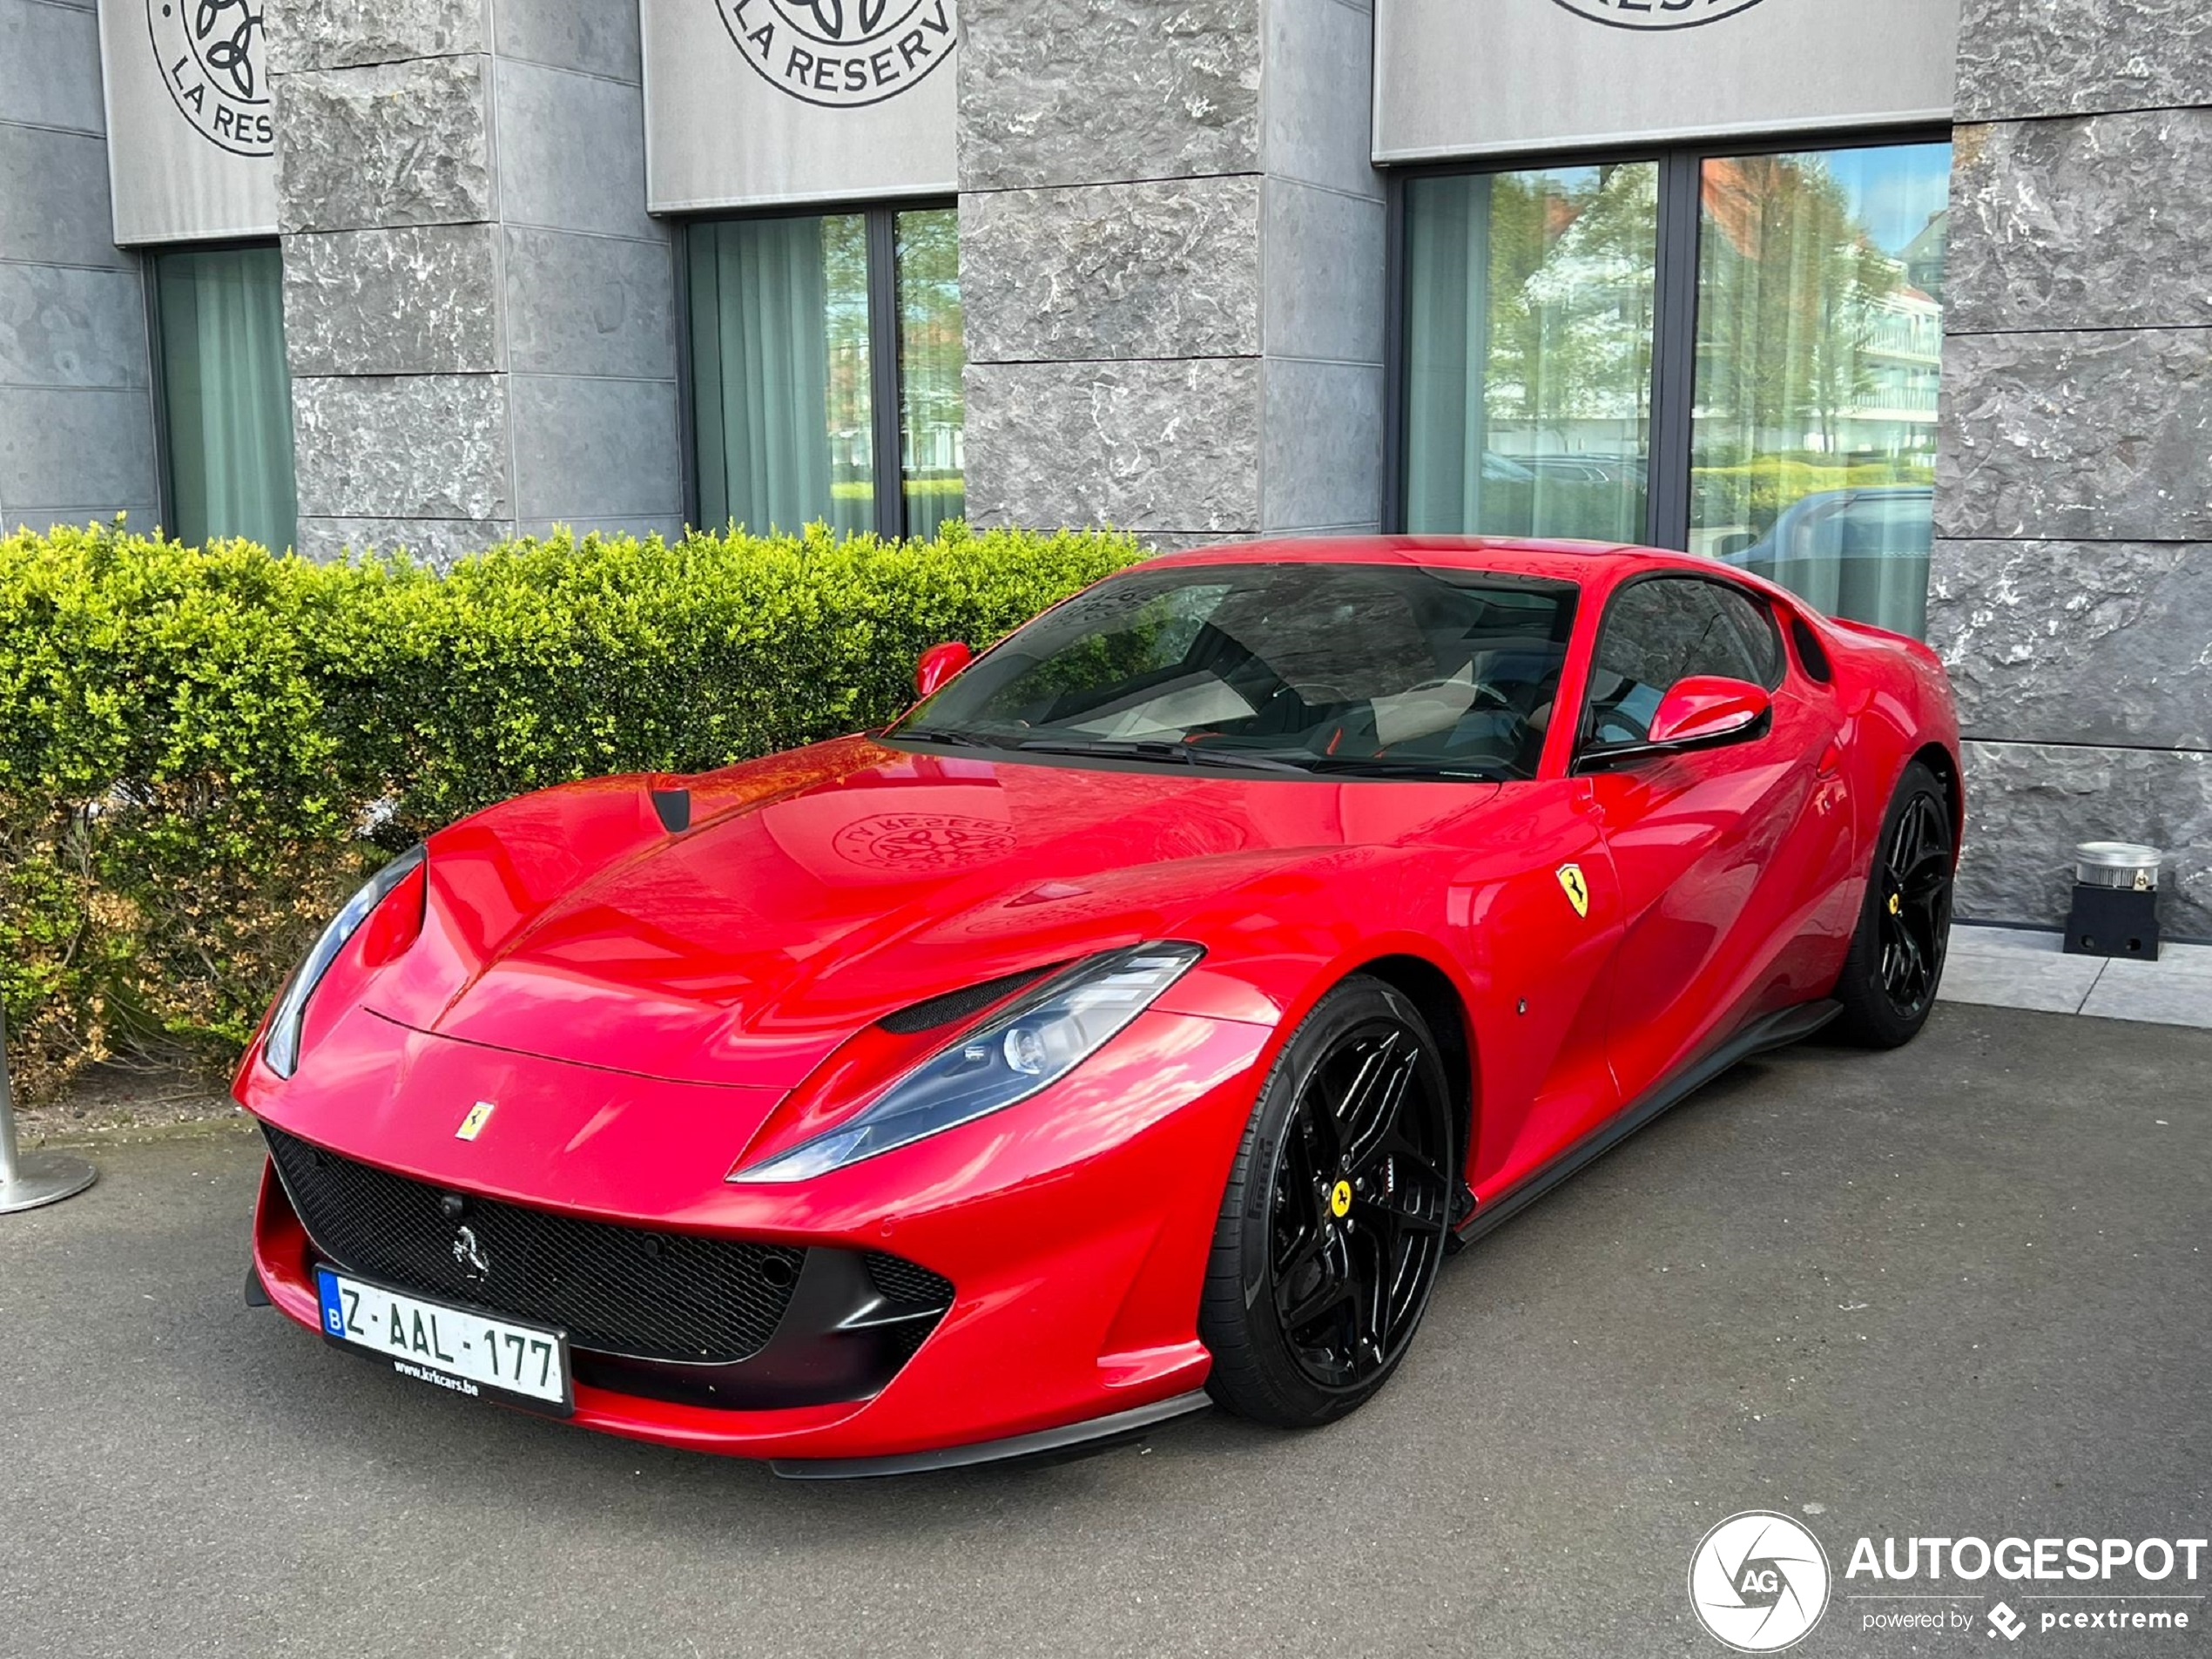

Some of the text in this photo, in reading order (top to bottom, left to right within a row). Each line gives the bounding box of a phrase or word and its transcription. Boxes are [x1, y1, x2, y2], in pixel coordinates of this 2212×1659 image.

[733, 0, 949, 93] LA RESERV
[172, 55, 206, 115] LA
[327, 1308, 341, 1331] B
